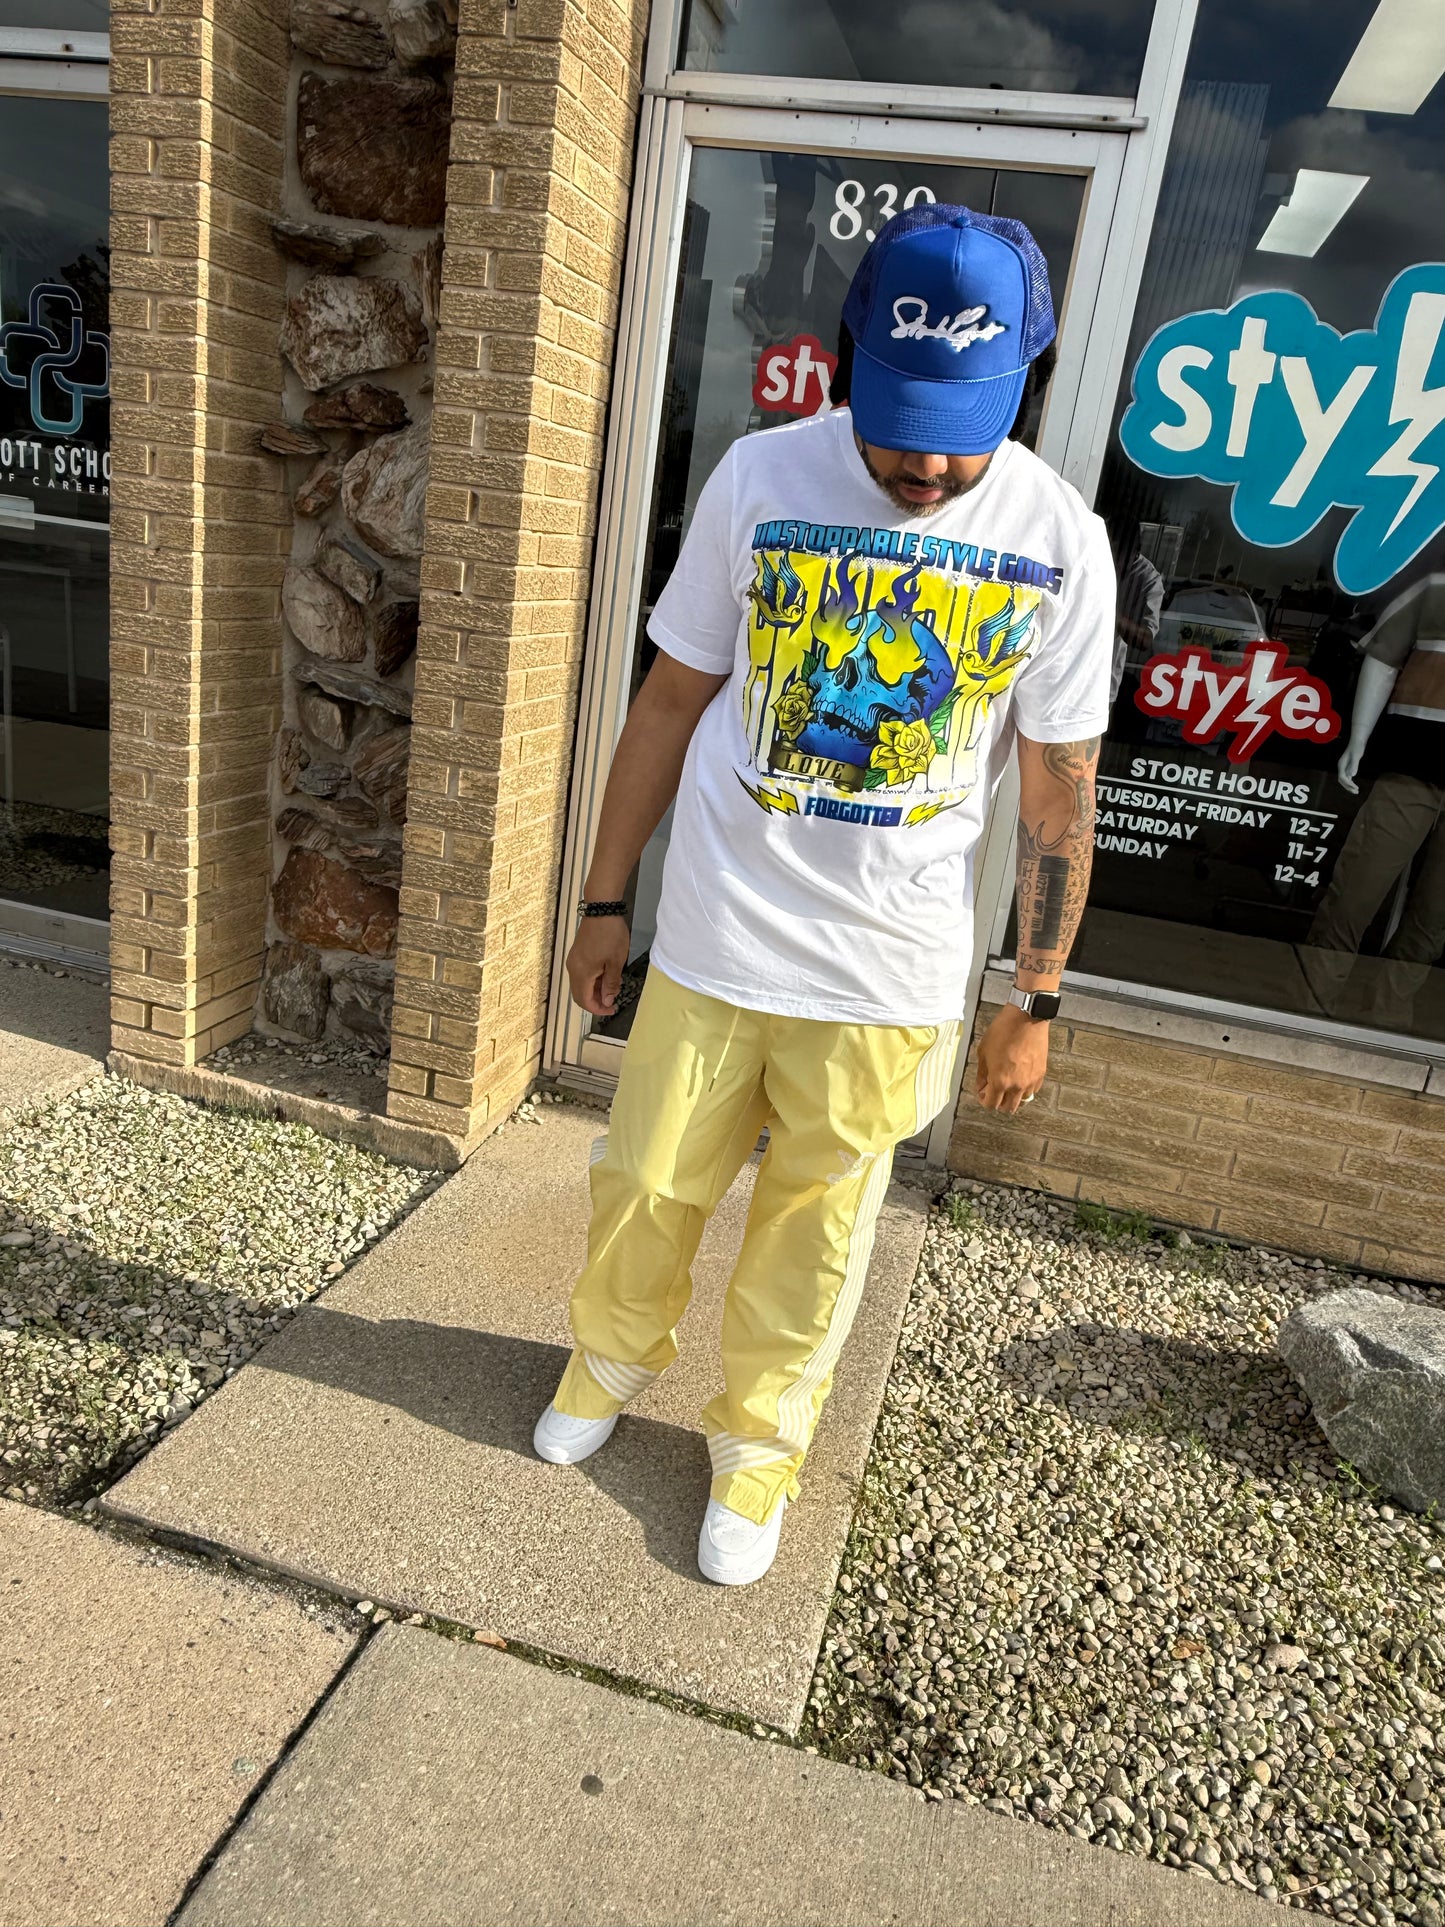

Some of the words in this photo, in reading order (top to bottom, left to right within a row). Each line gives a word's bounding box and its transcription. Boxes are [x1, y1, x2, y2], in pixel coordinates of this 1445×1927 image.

[1, 438, 42, 470] OTT
[54, 445, 112, 480] SCHO
[0, 472, 15, 482] F
[32, 477, 110, 496] CAREER
[752, 520, 921, 562] UNSTOPPABLE
[921, 536, 998, 578] STYLE
[1000, 553, 1064, 595] GODS
[785, 754, 845, 779] LOVE
[1130, 758, 1213, 787] STORE
[1217, 772, 1310, 804] HOURS
[1095, 808, 1198, 841] SATURDAY
[1287, 842, 1328, 863] 11-7
[1290, 817, 1334, 840] 12-7
[1274, 864, 1320, 887] 12-4
